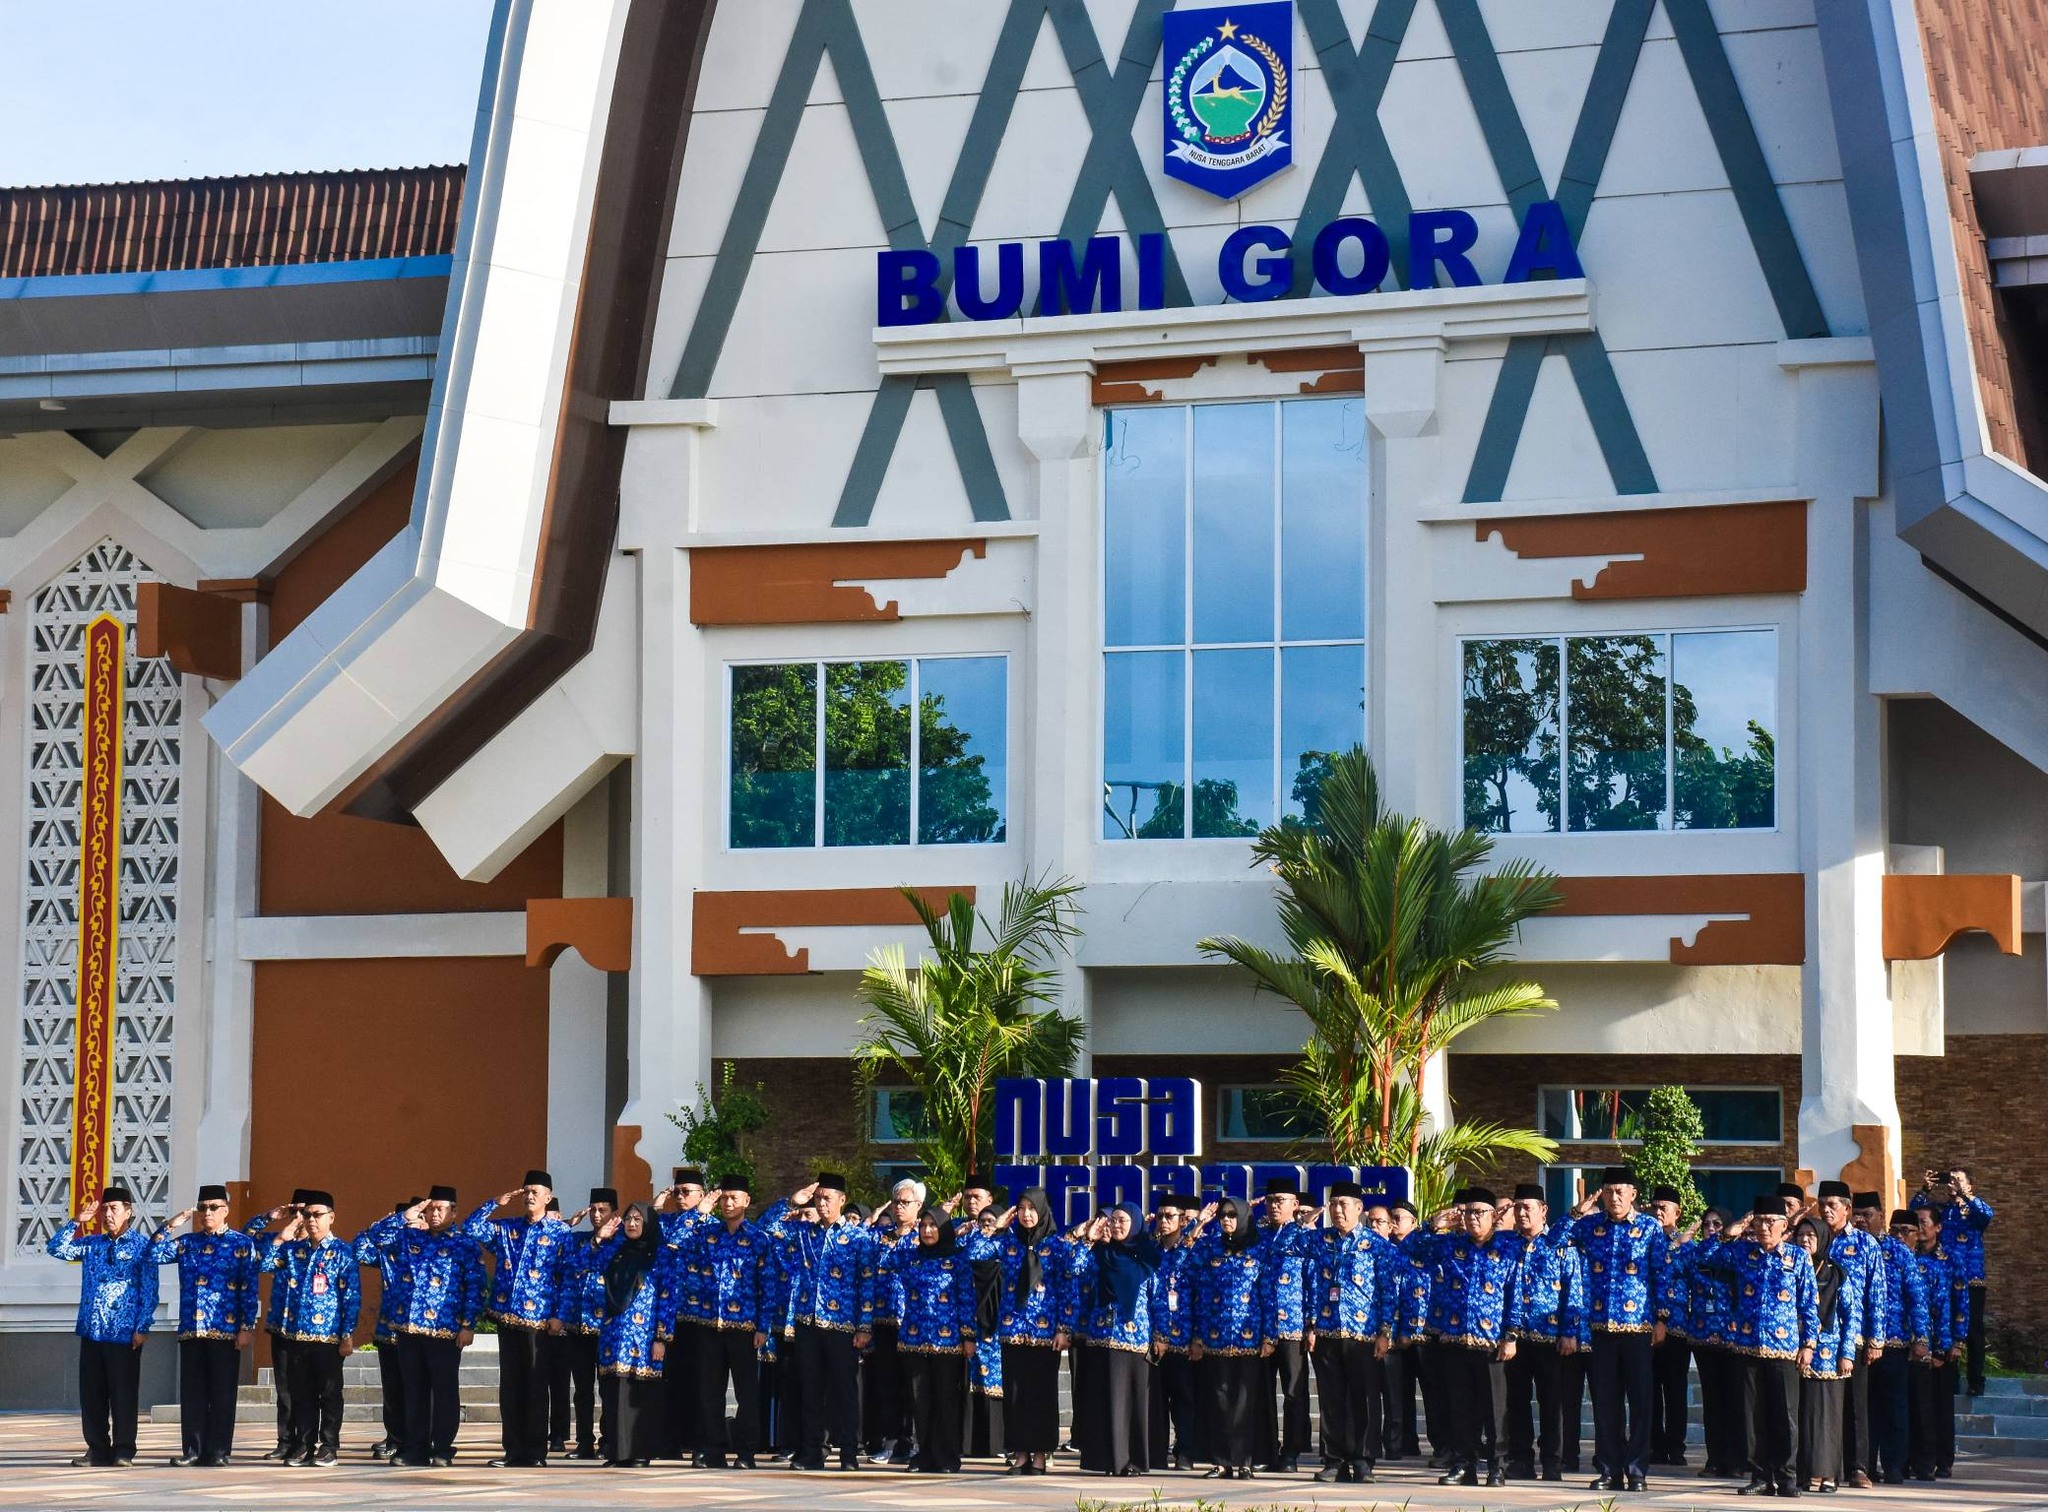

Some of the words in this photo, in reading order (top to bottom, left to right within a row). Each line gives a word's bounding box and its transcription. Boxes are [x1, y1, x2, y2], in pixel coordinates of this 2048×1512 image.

[1188, 149, 1207, 165] NUSA
[1208, 156, 1245, 167] TENGGARA
[1245, 143, 1266, 161] BARAT
[877, 233, 1165, 327] BUMI
[1218, 200, 1585, 302] GORA
